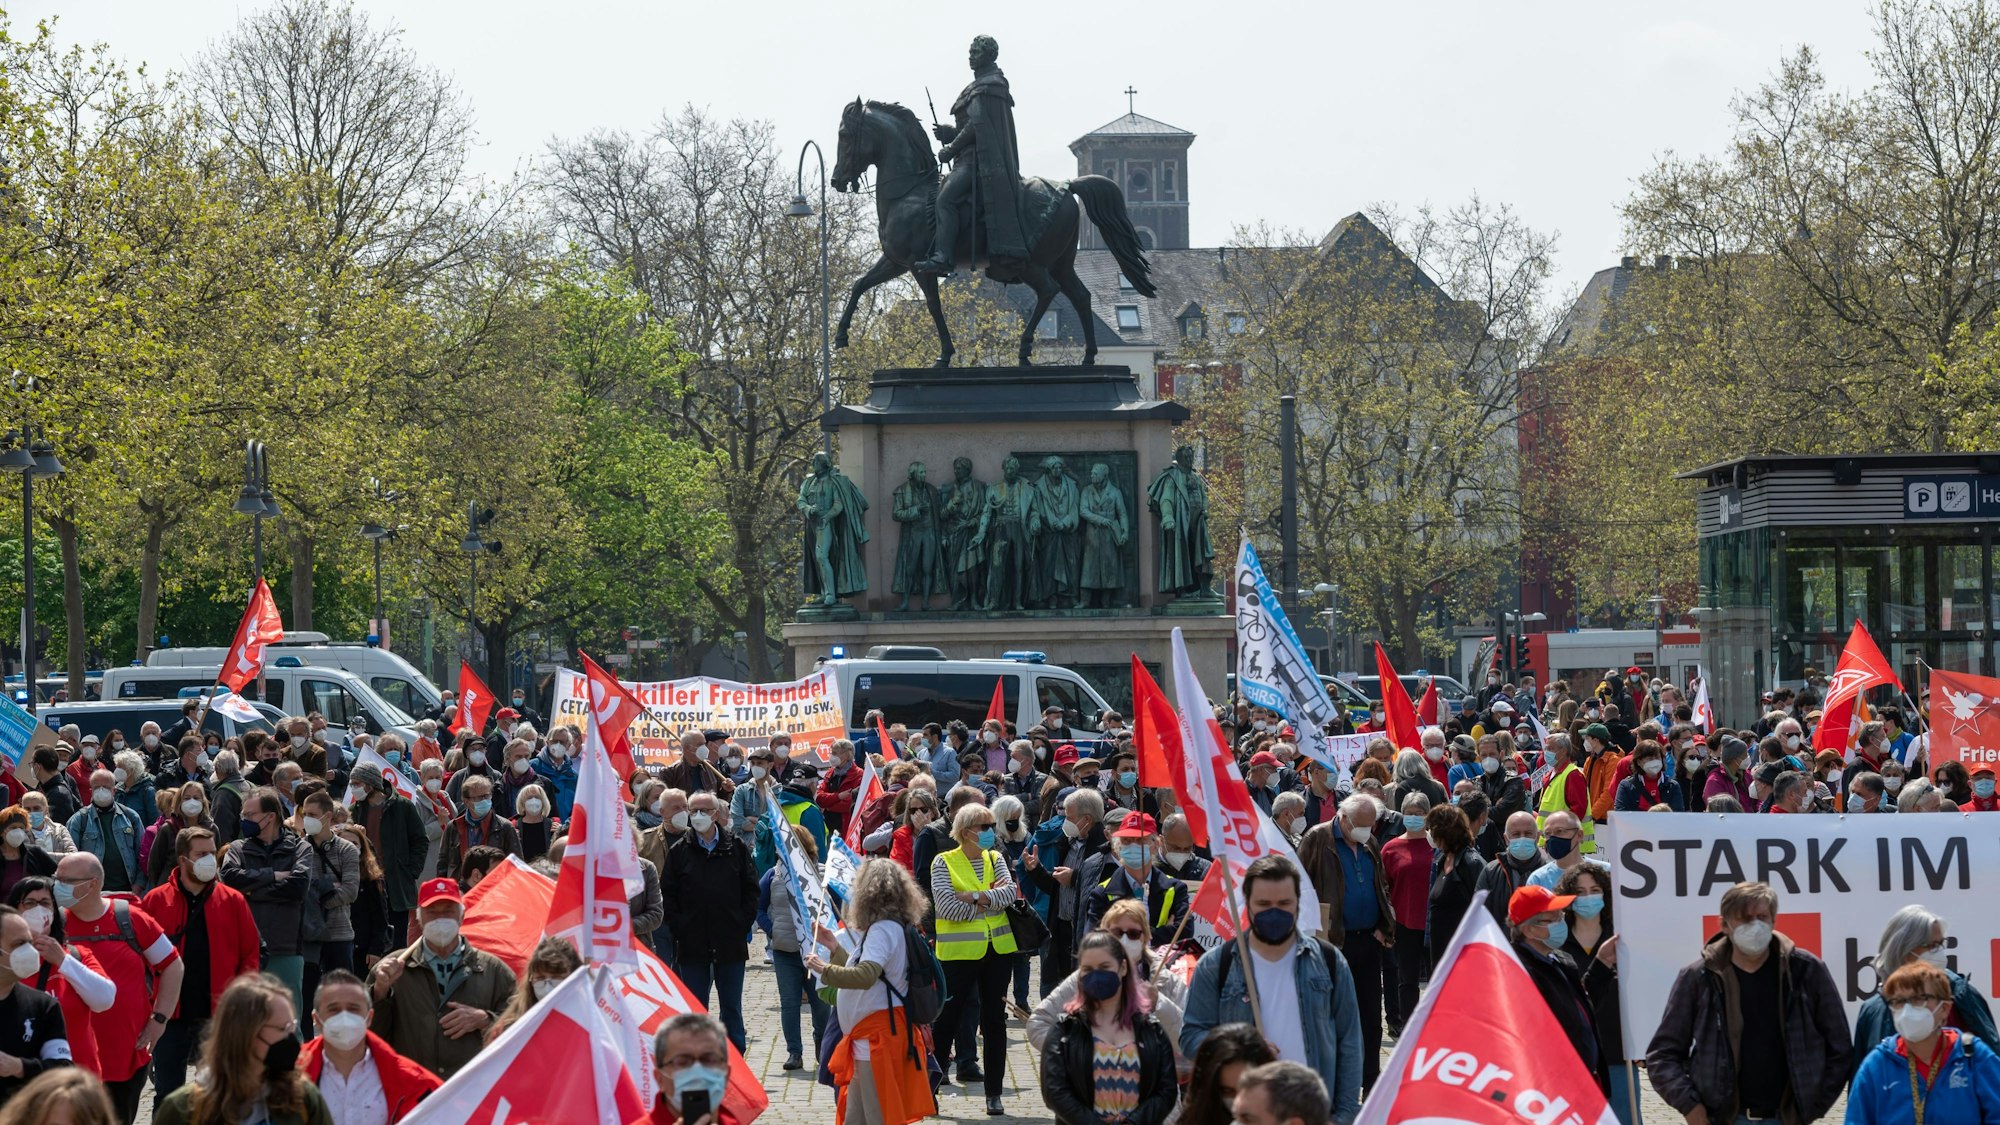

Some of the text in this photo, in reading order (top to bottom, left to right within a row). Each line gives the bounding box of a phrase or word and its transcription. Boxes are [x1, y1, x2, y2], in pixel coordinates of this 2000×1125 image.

[709, 673, 827, 706] Freihandel
[560, 698, 591, 716] CETA
[639, 707, 713, 723] Mercosur
[735, 706, 768, 721] TTIP
[774, 703, 799, 720] 2.0
[804, 701, 834, 716] usw.
[787, 722, 805, 734] an
[1620, 836, 1971, 899] STARK IM
